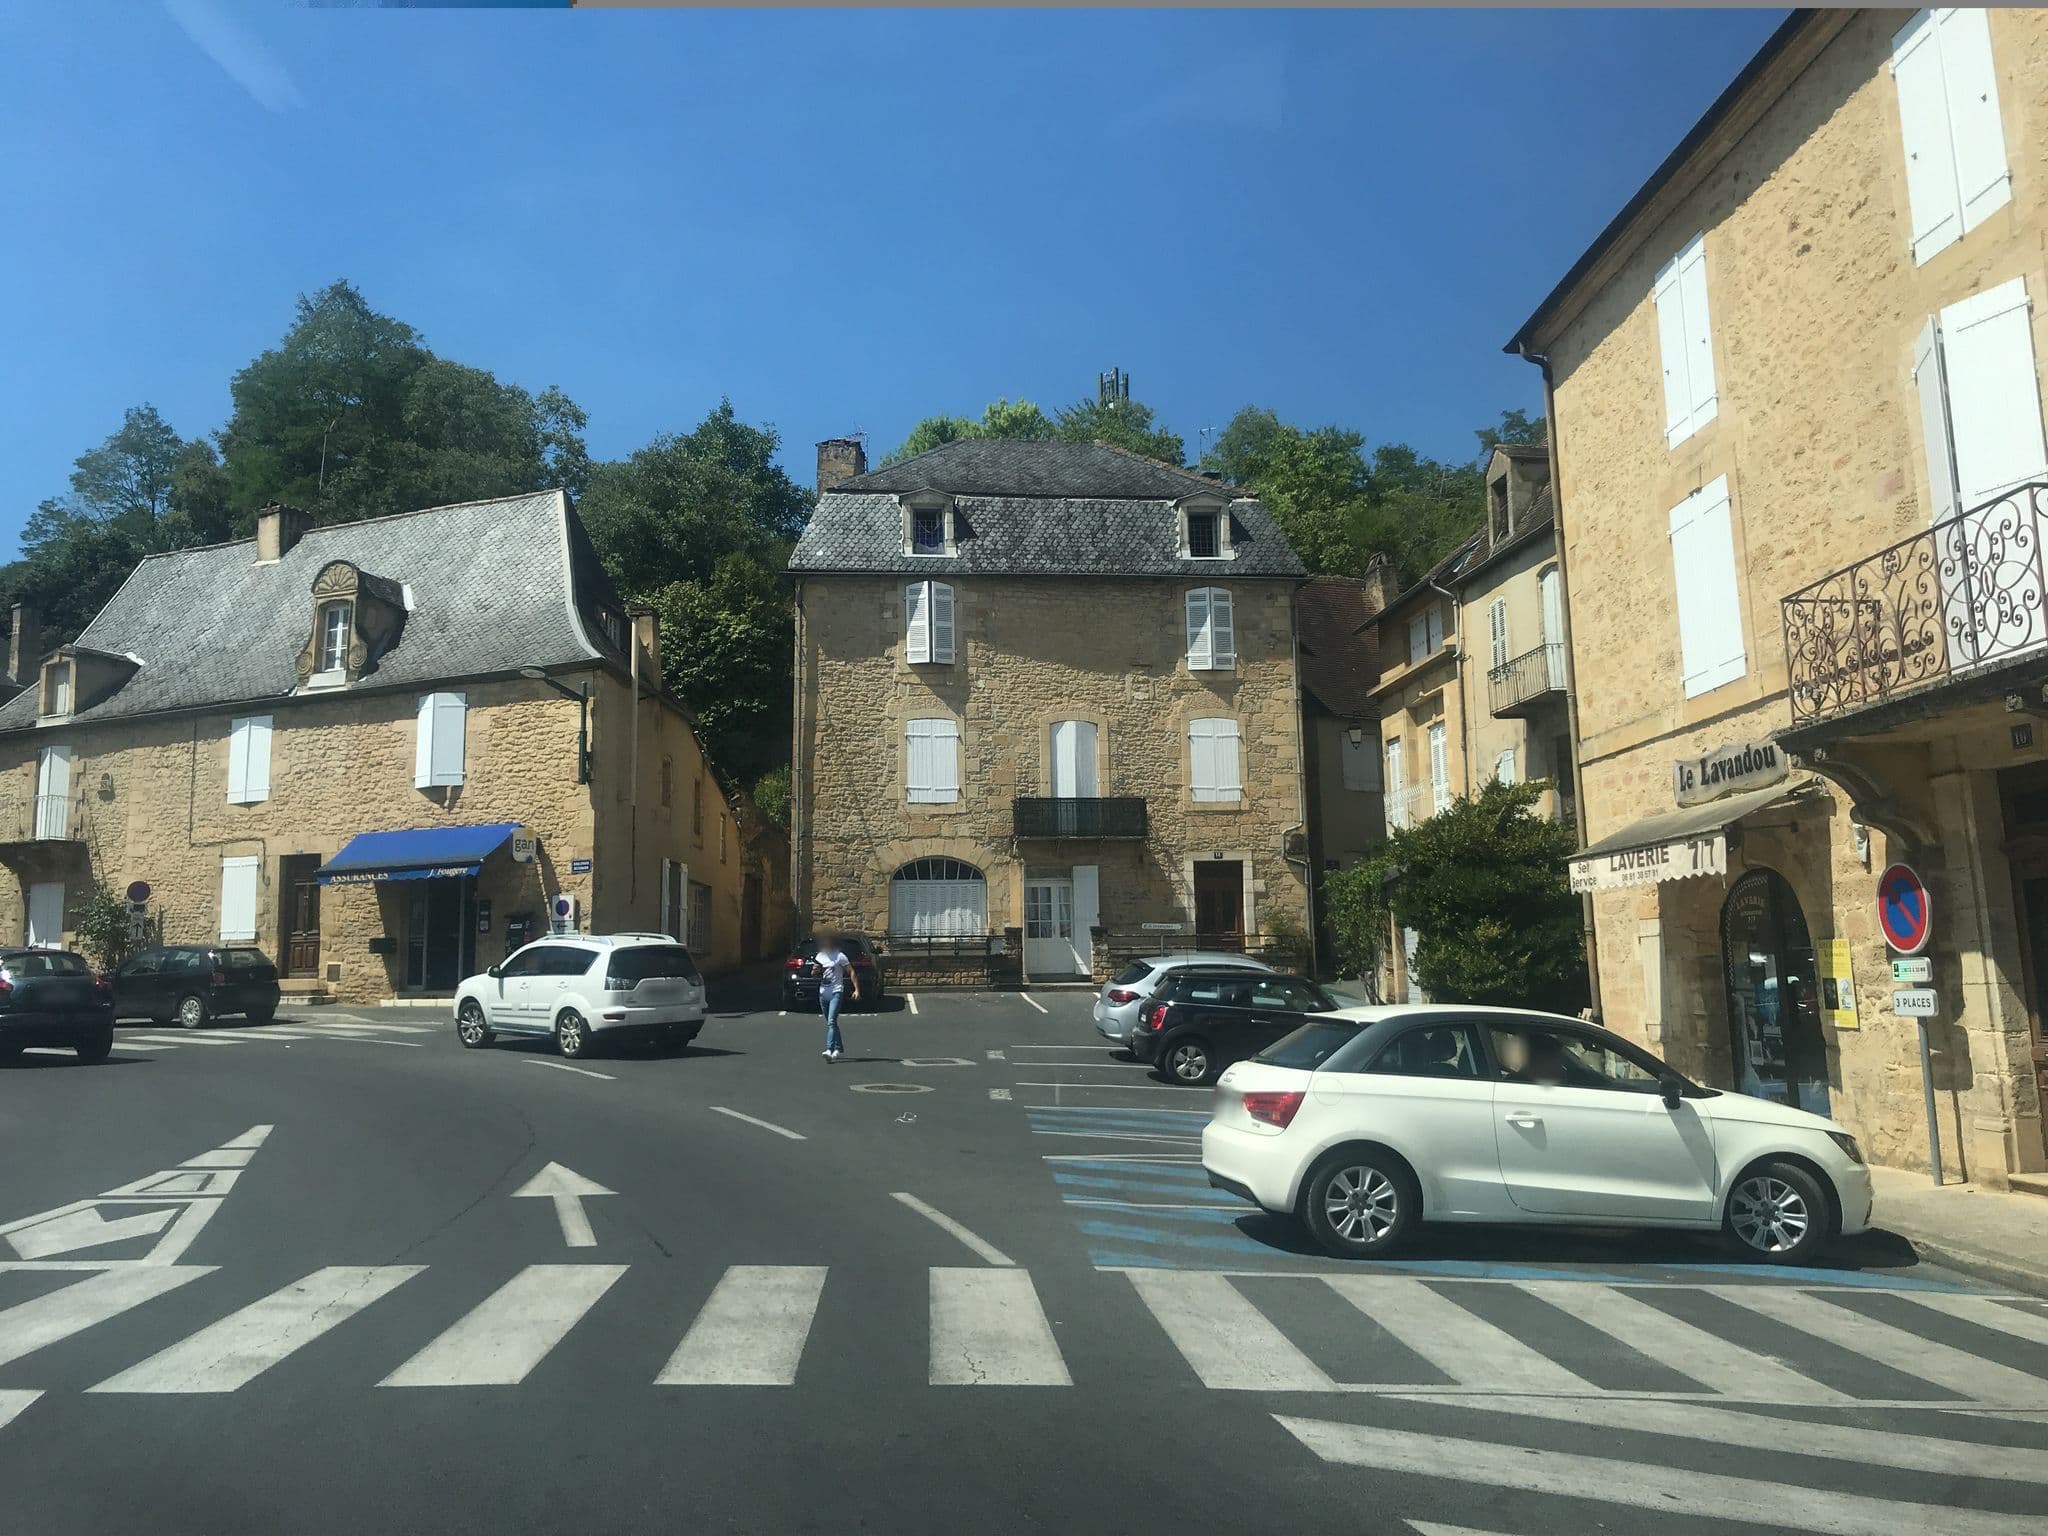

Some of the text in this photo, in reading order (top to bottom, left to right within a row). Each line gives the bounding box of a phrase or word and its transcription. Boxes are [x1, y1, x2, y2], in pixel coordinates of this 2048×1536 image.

[1679, 743, 1776, 791] Le Lavandou
[514, 838, 535, 853] gan
[1610, 845, 1670, 872] LAVERIE
[329, 871, 389, 884] ASSURANCES
[1572, 876, 1597, 889] Servce
[1896, 998, 1931, 1008] 3 PLACES
